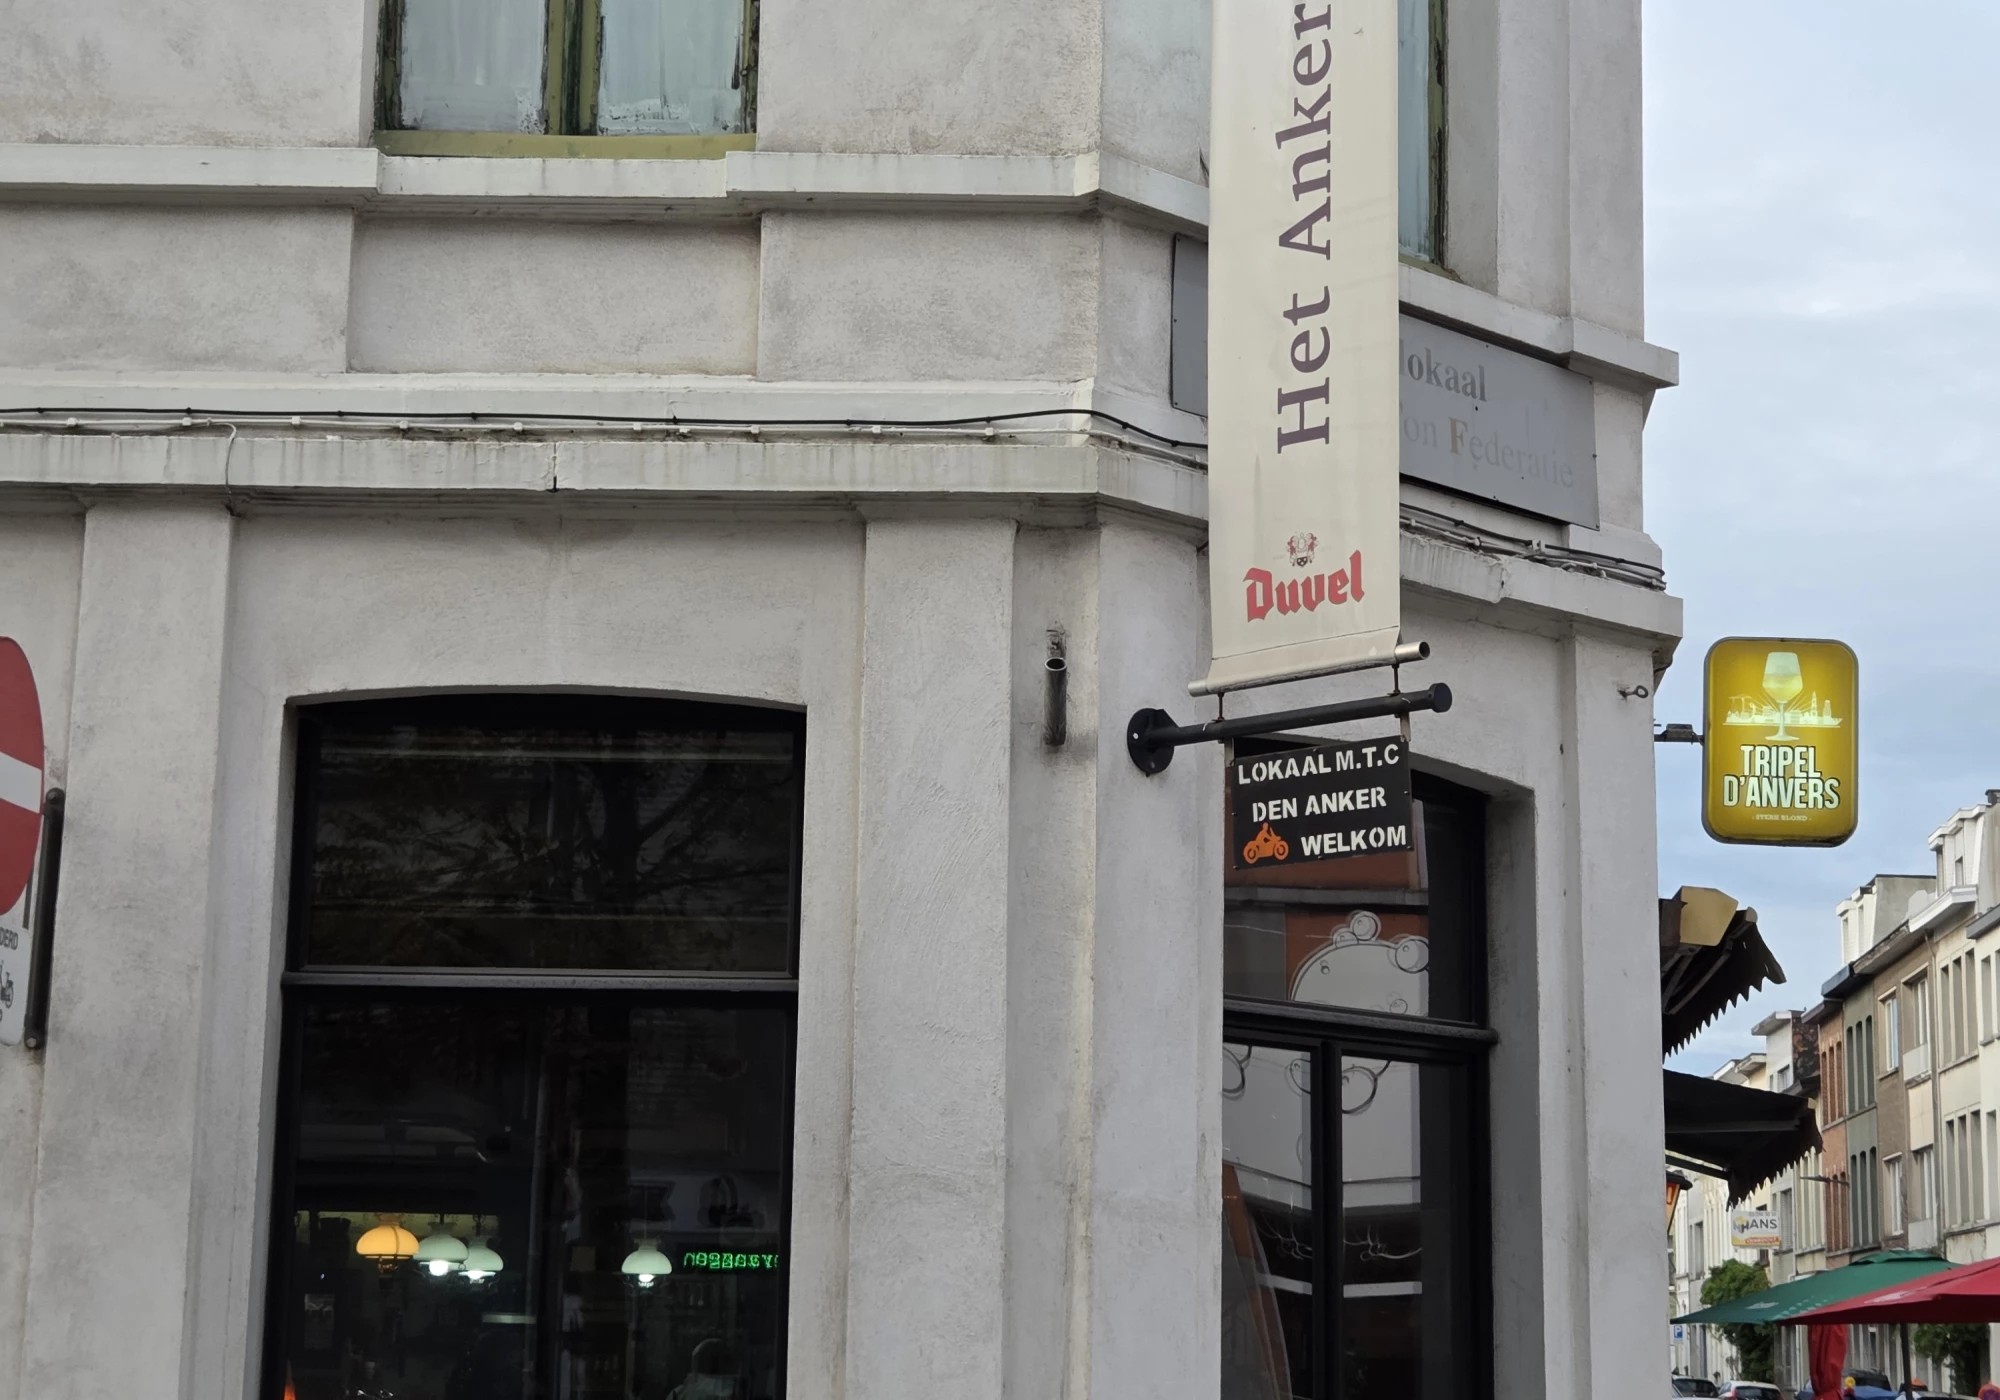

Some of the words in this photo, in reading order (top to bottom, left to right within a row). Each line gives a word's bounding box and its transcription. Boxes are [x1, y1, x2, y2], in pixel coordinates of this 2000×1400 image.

[1275, 2, 1332, 261] Anker
[1276, 284, 1331, 455] Het
[1242, 550, 1366, 623] Duvel
[1238, 753, 1332, 785] LOKAAL
[1335, 743, 1400, 772] M.T.C
[1740, 744, 1822, 778] TRIPEL
[1252, 797, 1298, 823] DEN
[1304, 786, 1387, 816] ANKER
[1723, 774, 1840, 809] D'ANVERS
[1300, 825, 1407, 857] WELKOM
